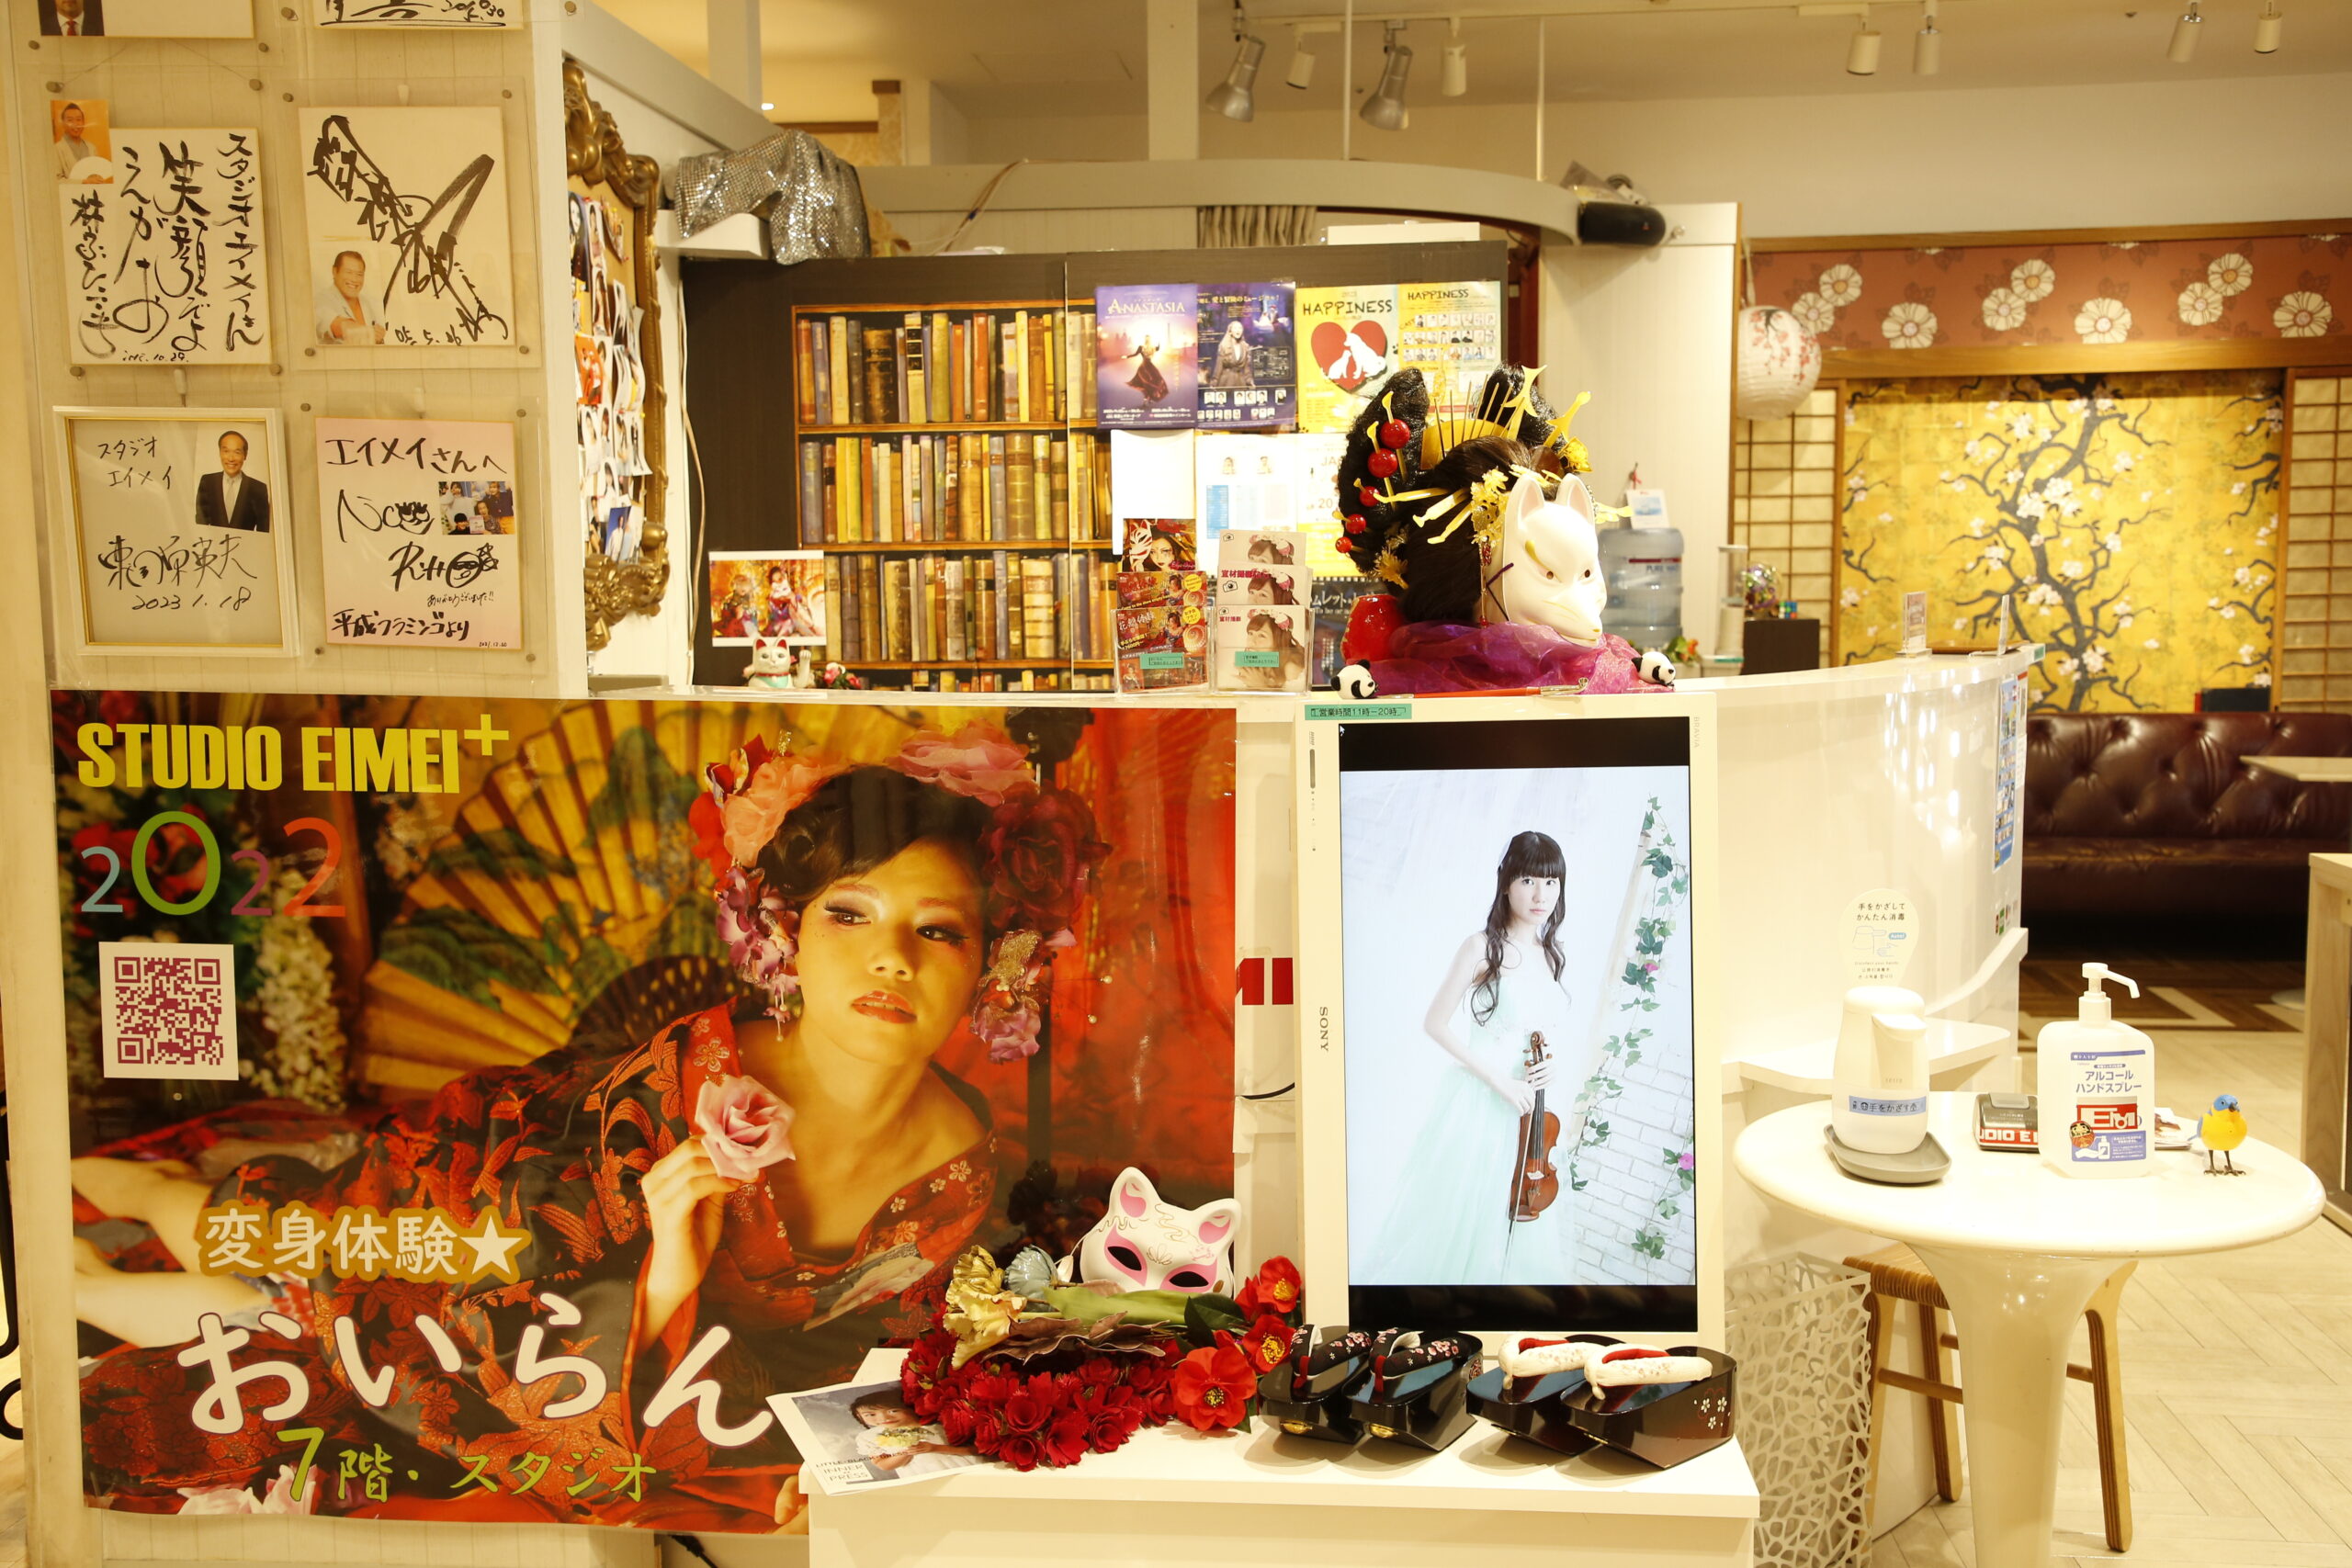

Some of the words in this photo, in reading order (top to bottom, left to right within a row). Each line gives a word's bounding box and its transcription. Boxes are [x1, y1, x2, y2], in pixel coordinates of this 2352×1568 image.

[1408, 288, 1469, 300] HAPPINESS
[1108, 299, 1185, 314] ANASTASIA
[1303, 299, 1393, 315] HAPPINESS
[97, 436, 157, 460] スタジオ
[325, 437, 507, 475] エイメイさんへ
[107, 465, 172, 491] エイメイ
[131, 594, 182, 611] 2023
[77, 723, 282, 791] STUDIO
[81, 811, 346, 918] 2022
[1858, 902, 1905, 911] 手をかざして
[1856, 912, 1905, 921] かんたん消毒
[1319, 1006, 1329, 1053] SONY
[2086, 1070, 2133, 1081] アルコール
[2076, 1082, 2142, 1093] ハンドスプレー
[204, 1206, 460, 1276] 変身体験
[177, 1292, 773, 1448] おいらん
[823, 1464, 864, 1473] INNER
[829, 1472, 868, 1482] PRESS
